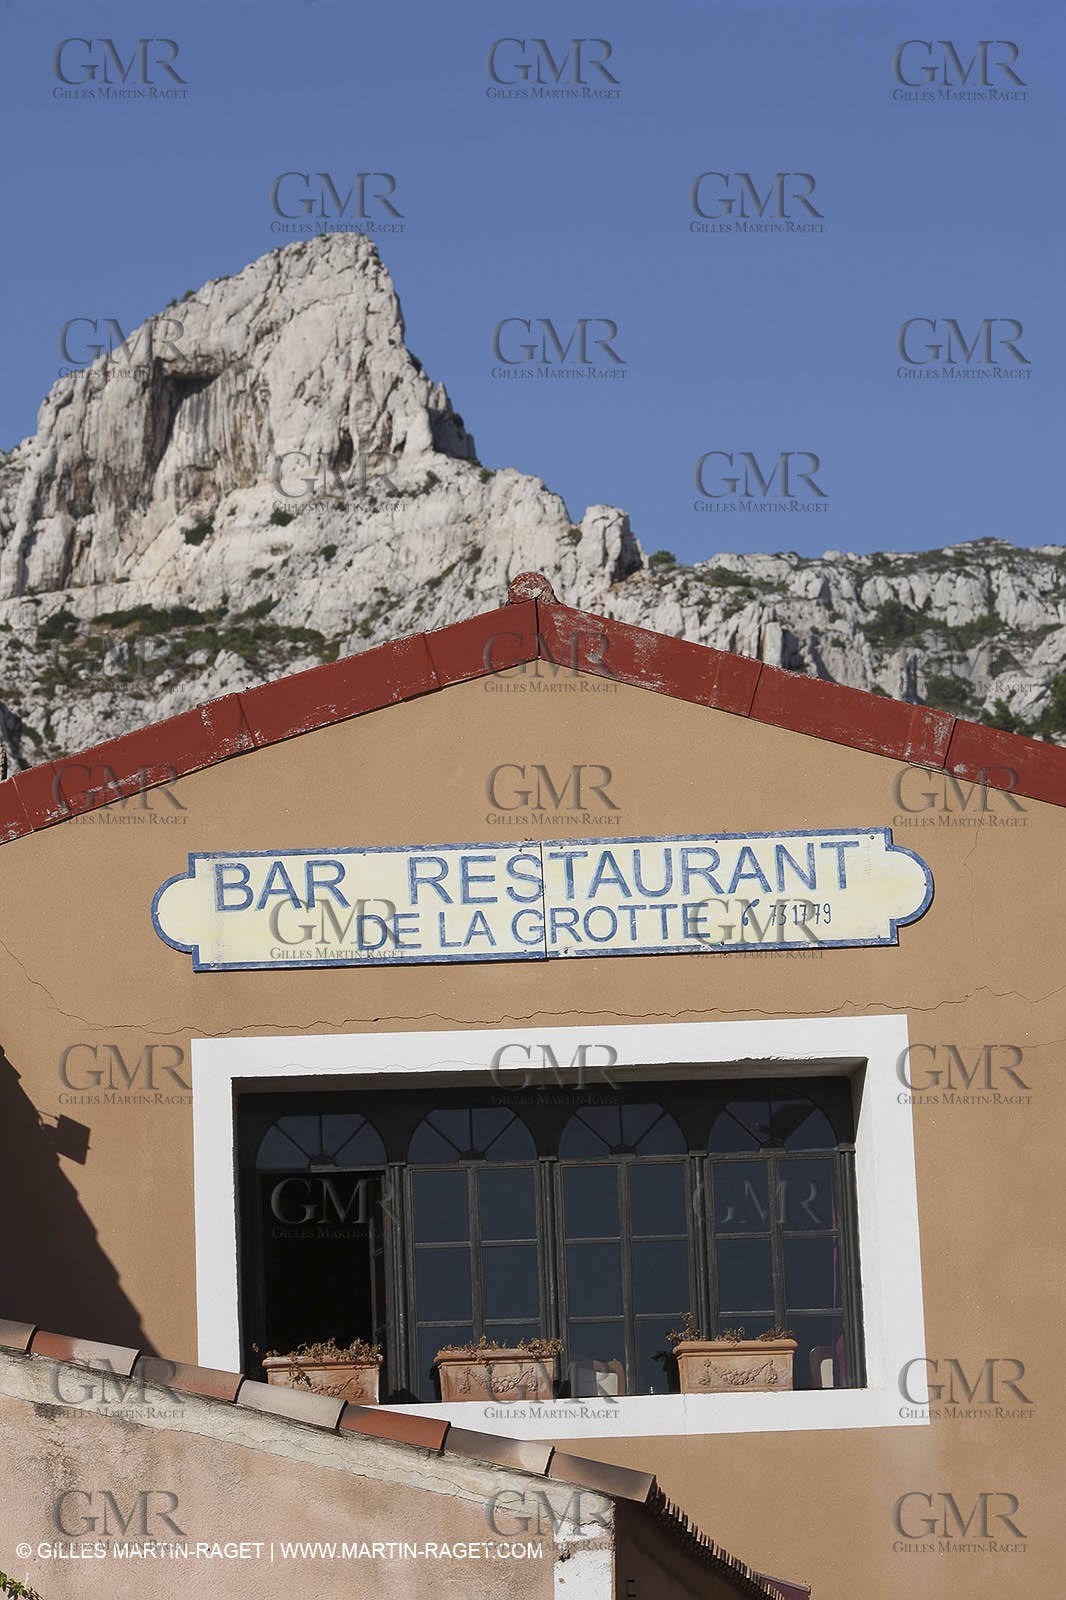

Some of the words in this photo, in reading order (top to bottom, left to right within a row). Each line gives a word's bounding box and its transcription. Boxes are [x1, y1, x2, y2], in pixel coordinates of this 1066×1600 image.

[215, 859, 350, 912] BAR
[408, 840, 860, 905] RESTAURANT
[356, 912, 422, 951] DE
[439, 910, 497, 947] LA
[511, 902, 711, 946] GROTTE
